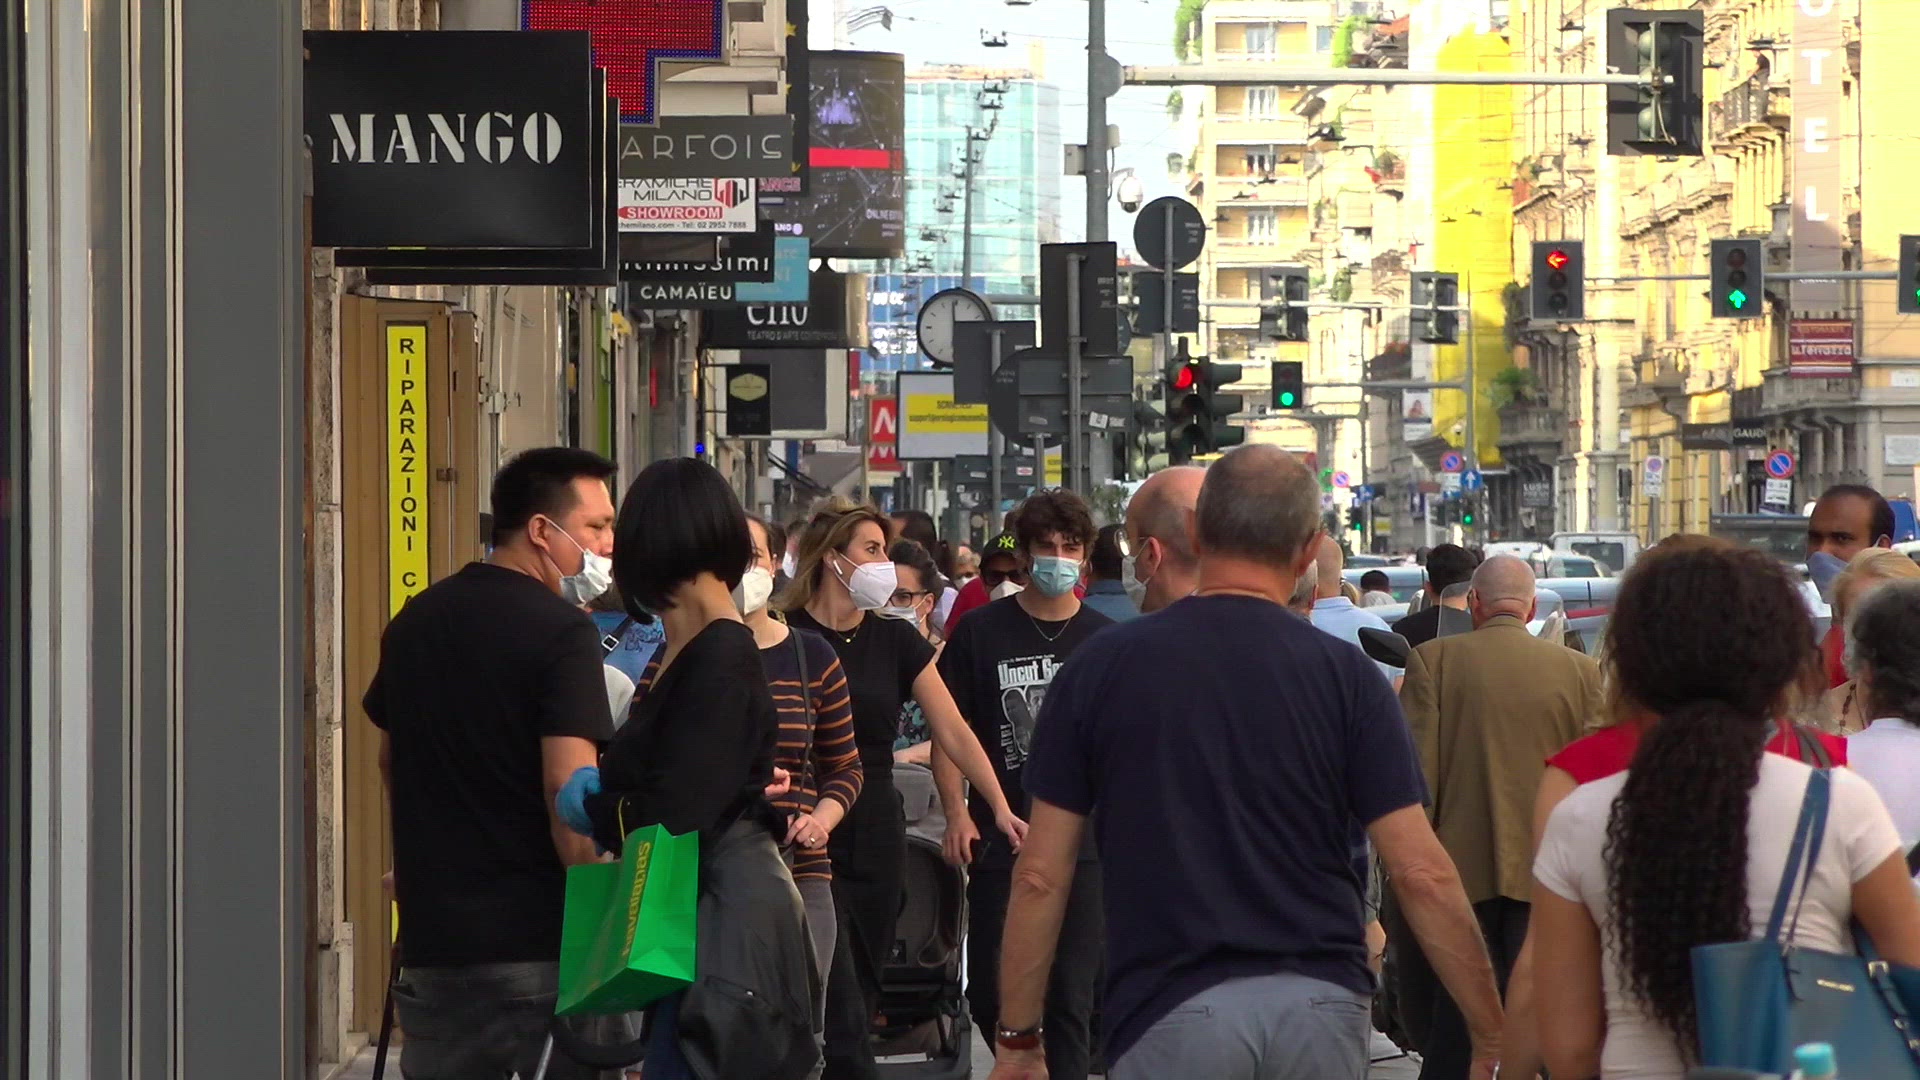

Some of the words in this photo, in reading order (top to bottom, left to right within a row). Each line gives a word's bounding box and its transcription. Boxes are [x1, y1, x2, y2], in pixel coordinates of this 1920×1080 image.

[329, 111, 563, 164] MANGO
[621, 134, 782, 160] ARFOIS
[634, 190, 712, 201] MILANO
[627, 207, 720, 219] SHOWROOM
[697, 221, 707, 229] 02
[708, 221, 726, 229] 2952
[640, 282, 732, 300] CAMAÏEU
[399, 338, 417, 551] RIPARAZIONI
[997, 660, 1039, 685] Uncut
